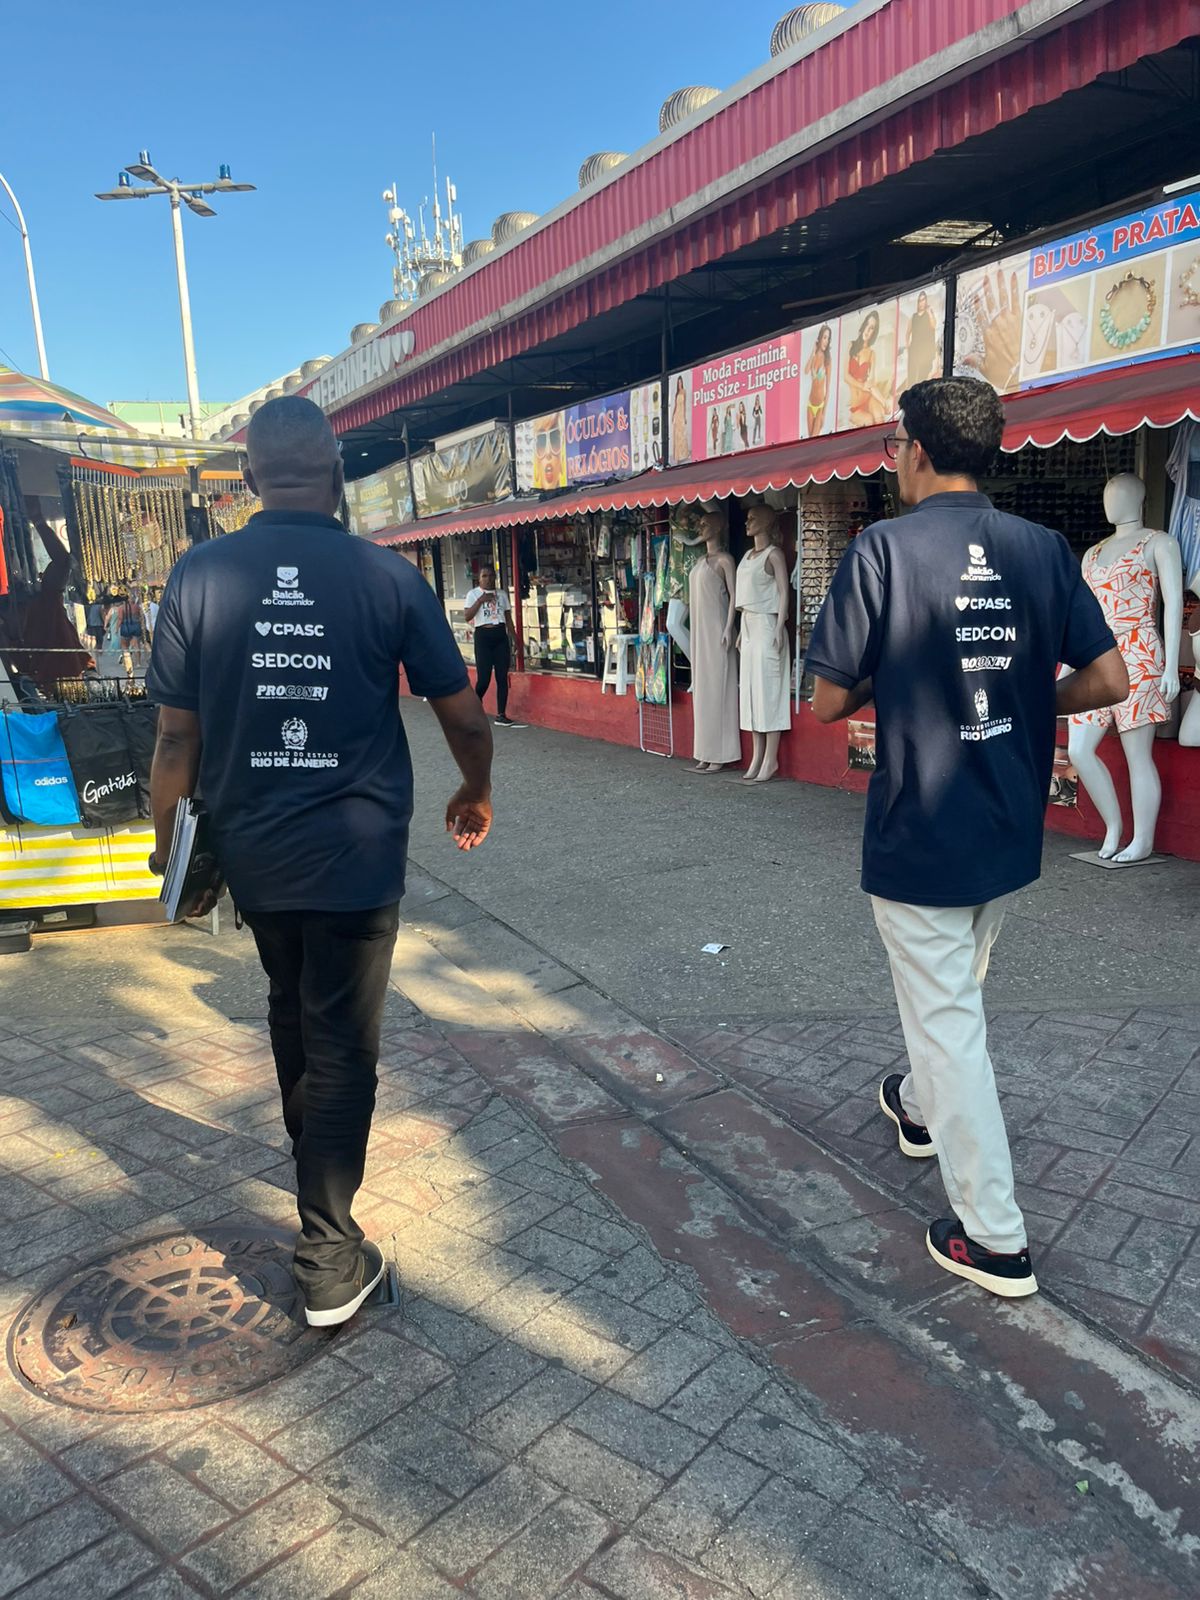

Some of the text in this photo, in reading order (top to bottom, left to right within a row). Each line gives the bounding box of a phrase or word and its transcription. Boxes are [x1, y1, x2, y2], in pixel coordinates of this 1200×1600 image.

[1033, 203, 1200, 279] BIJUS, PRATA
[702, 345, 787, 385] Moda Feminina
[321, 339, 384, 407] FEIRINHA
[693, 388, 715, 407] Plus
[717, 380, 740, 399] Size
[747, 360, 798, 390] Lingerie
[566, 407, 629, 444] ÓCULOS &
[567, 445, 629, 479] RELÓGIOS
[272, 590, 305, 599] Balcão
[272, 598, 315, 606] Consumidor
[970, 598, 1012, 610] CPASC
[272, 624, 325, 637] CPASC
[955, 626, 1016, 642] SEDCON
[251, 653, 332, 670] SEDCON
[256, 685, 329, 700] PROCONRJ
[960, 731, 981, 741] RIO
[251, 757, 338, 769] RIO DE JANEIRO
[34, 776, 68, 786] adidas
